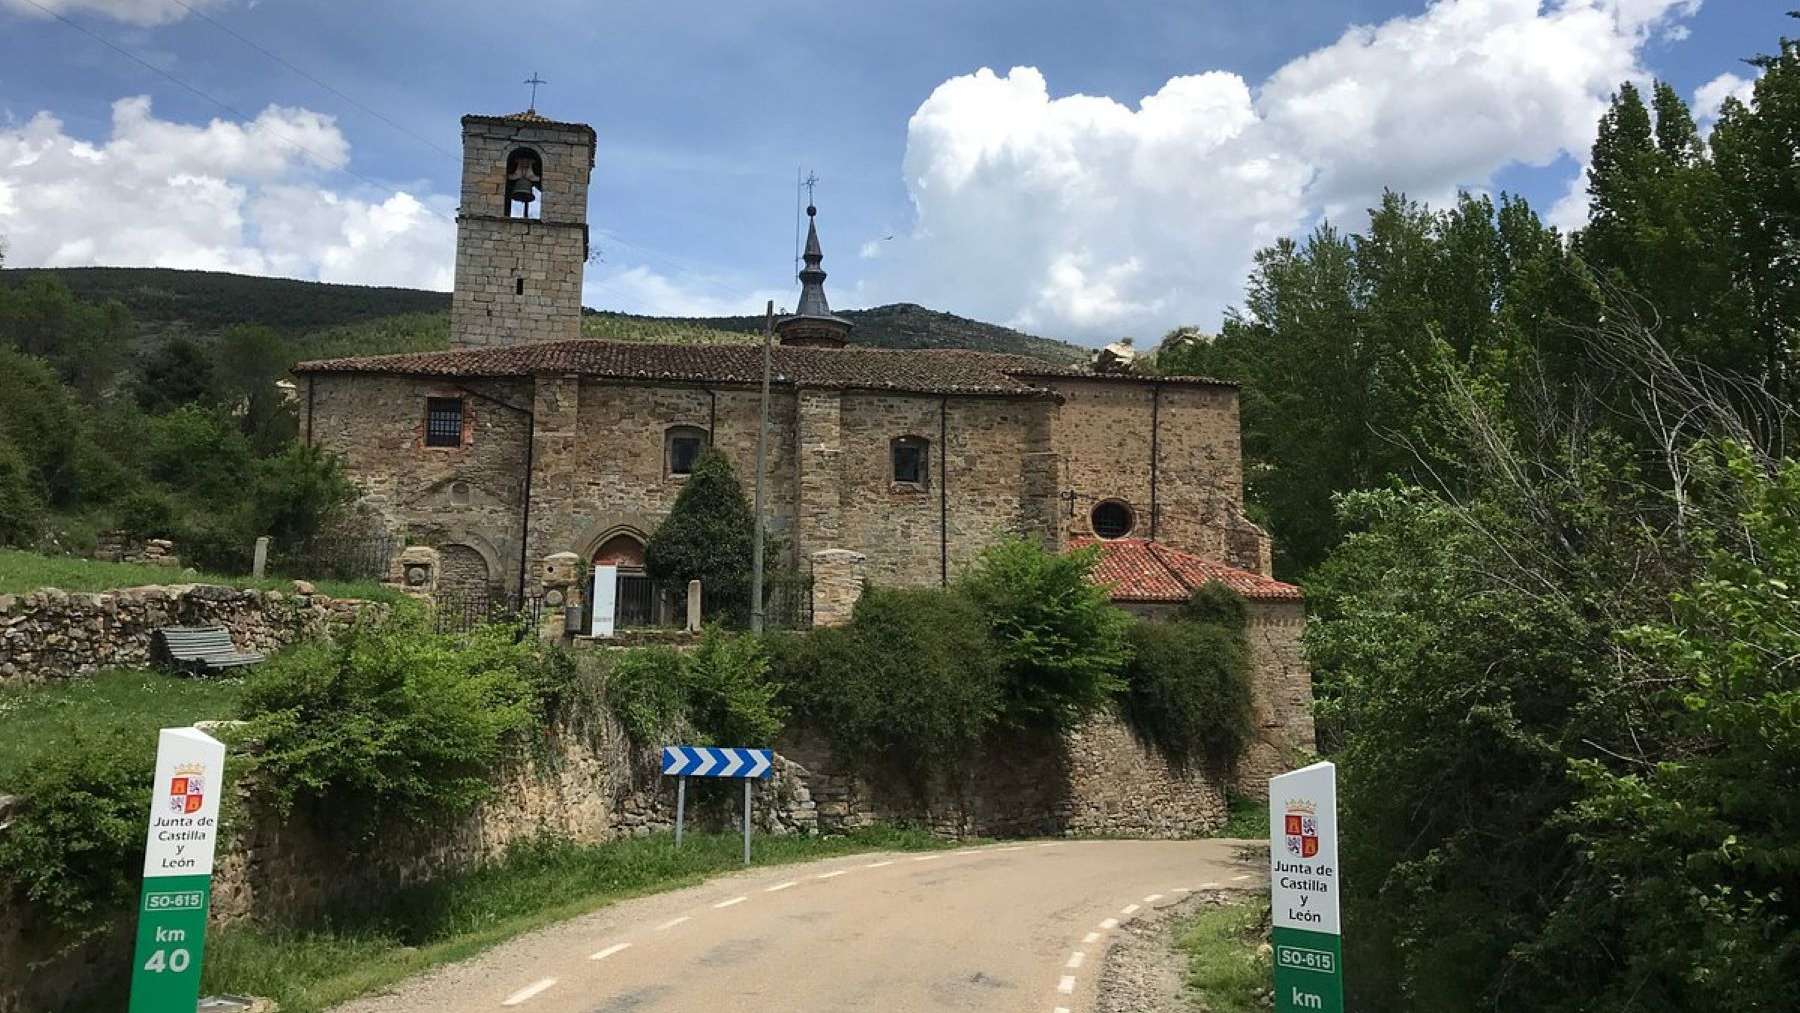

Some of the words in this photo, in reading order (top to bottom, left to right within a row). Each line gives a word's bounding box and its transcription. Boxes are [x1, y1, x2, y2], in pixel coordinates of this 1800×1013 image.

[153, 816, 193, 828] Junta
[197, 816, 214, 827] de
[158, 830, 206, 842] Castilla
[176, 844, 185, 855] y
[162, 857, 195, 868] León
[1274, 860, 1312, 876] Junta
[1316, 865, 1333, 877] de
[1280, 876, 1328, 893] Castilla
[149, 894, 200, 908] SO-615
[1300, 894, 1309, 907] y
[1289, 908, 1321, 923] León
[156, 926, 185, 942] km
[144, 949, 190, 973] 40
[1281, 950, 1331, 969] SO-615
[1292, 987, 1322, 1009] km
